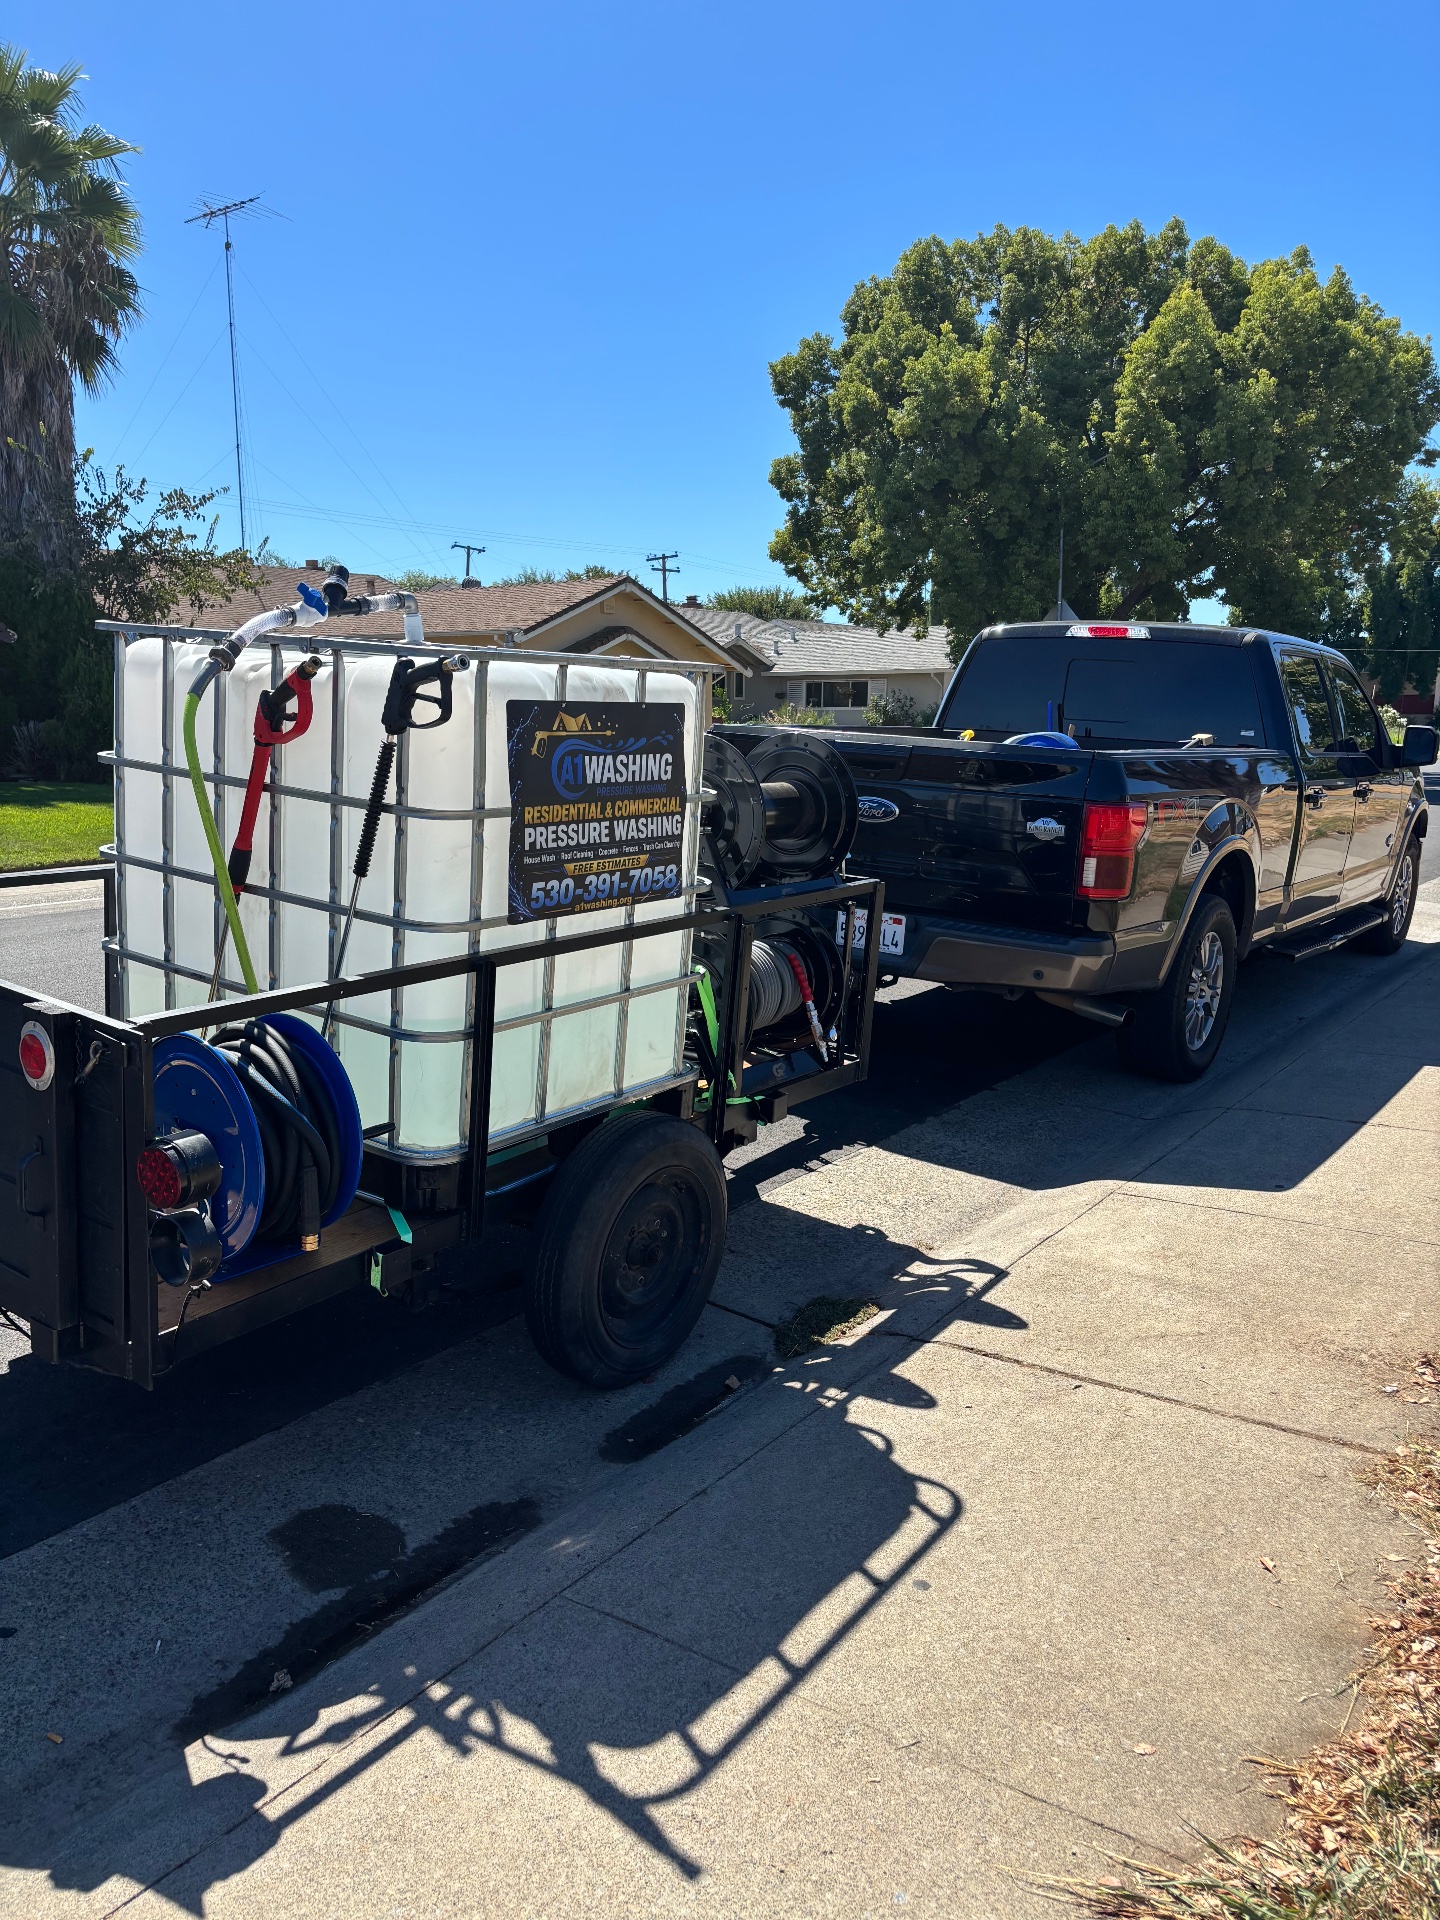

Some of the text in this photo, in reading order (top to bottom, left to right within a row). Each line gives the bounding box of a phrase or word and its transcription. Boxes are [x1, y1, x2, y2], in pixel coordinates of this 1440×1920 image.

[596, 783, 667, 797] PRESSURE WASHING
[524, 797, 682, 825] RESIDENTIAL & COMMERCIAL
[859, 801, 885, 817] Ford
[1157, 797, 1200, 828] FX4
[524, 814, 682, 851] PRESSURE WASHING
[523, 856, 541, 865] House
[541, 853, 556, 863] Wash
[561, 852, 572, 860] Roof
[573, 850, 594, 859] Cleaning
[598, 847, 619, 856] Concrete
[622, 845, 639, 853] Fences
[643, 842, 655, 851] Trash
[655, 841, 664, 850] Can
[573, 857, 641, 874] FREE ESTIMATES
[530, 864, 677, 909] 530-391-7058
[574, 896, 632, 912] a1washing.org
